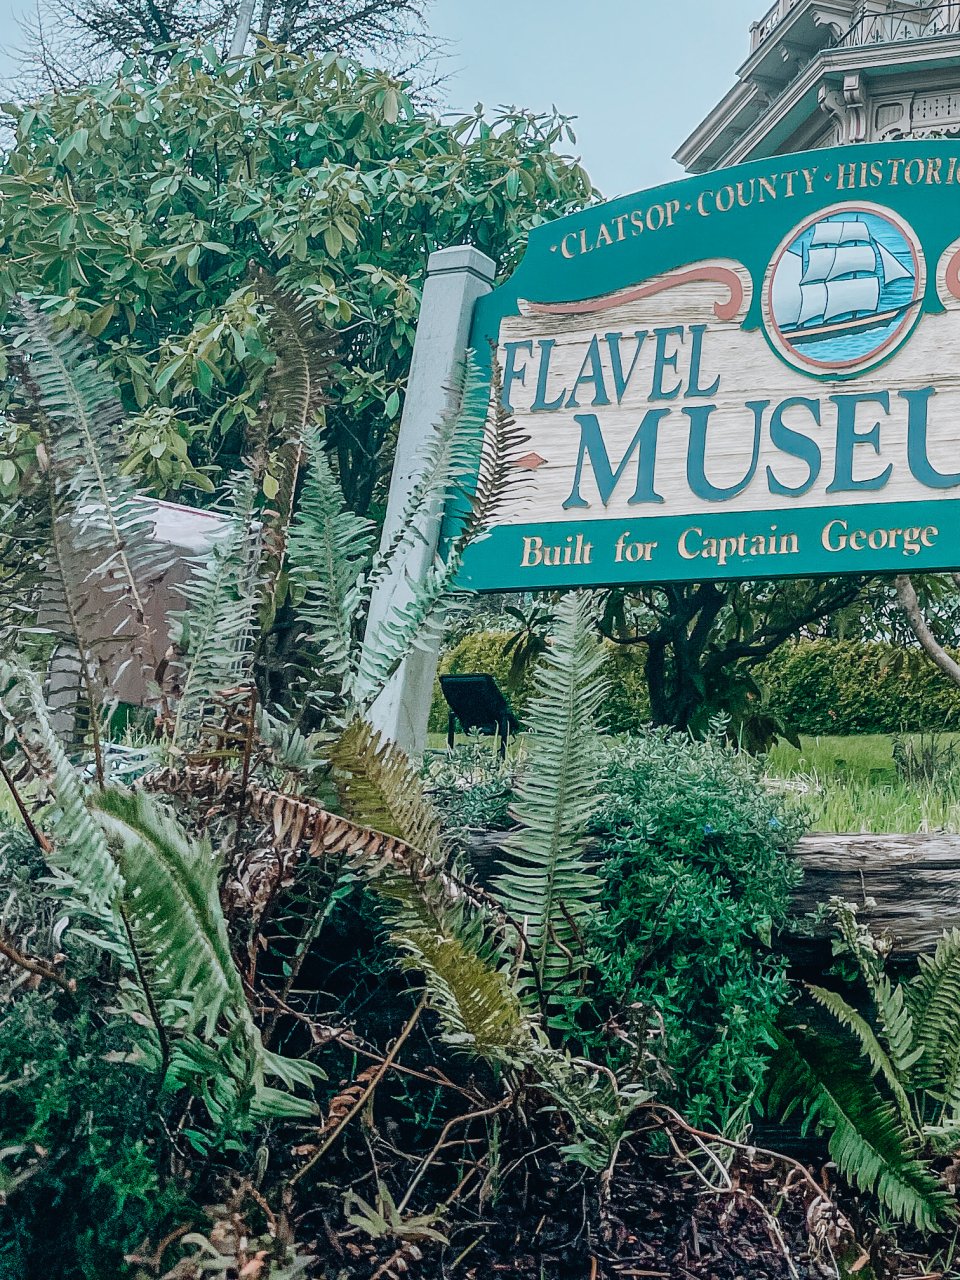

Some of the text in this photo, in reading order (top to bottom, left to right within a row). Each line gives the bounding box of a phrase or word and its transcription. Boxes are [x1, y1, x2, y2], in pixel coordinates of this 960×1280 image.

[560, 199, 680, 260] CLATSOP
[697, 167, 818, 217] COUNTY
[500, 323, 721, 414] FLAVEL
[520, 532, 594, 568] Built
[614, 530, 658, 563] for
[677, 523, 800, 566] Captain
[821, 518, 940, 556] George
